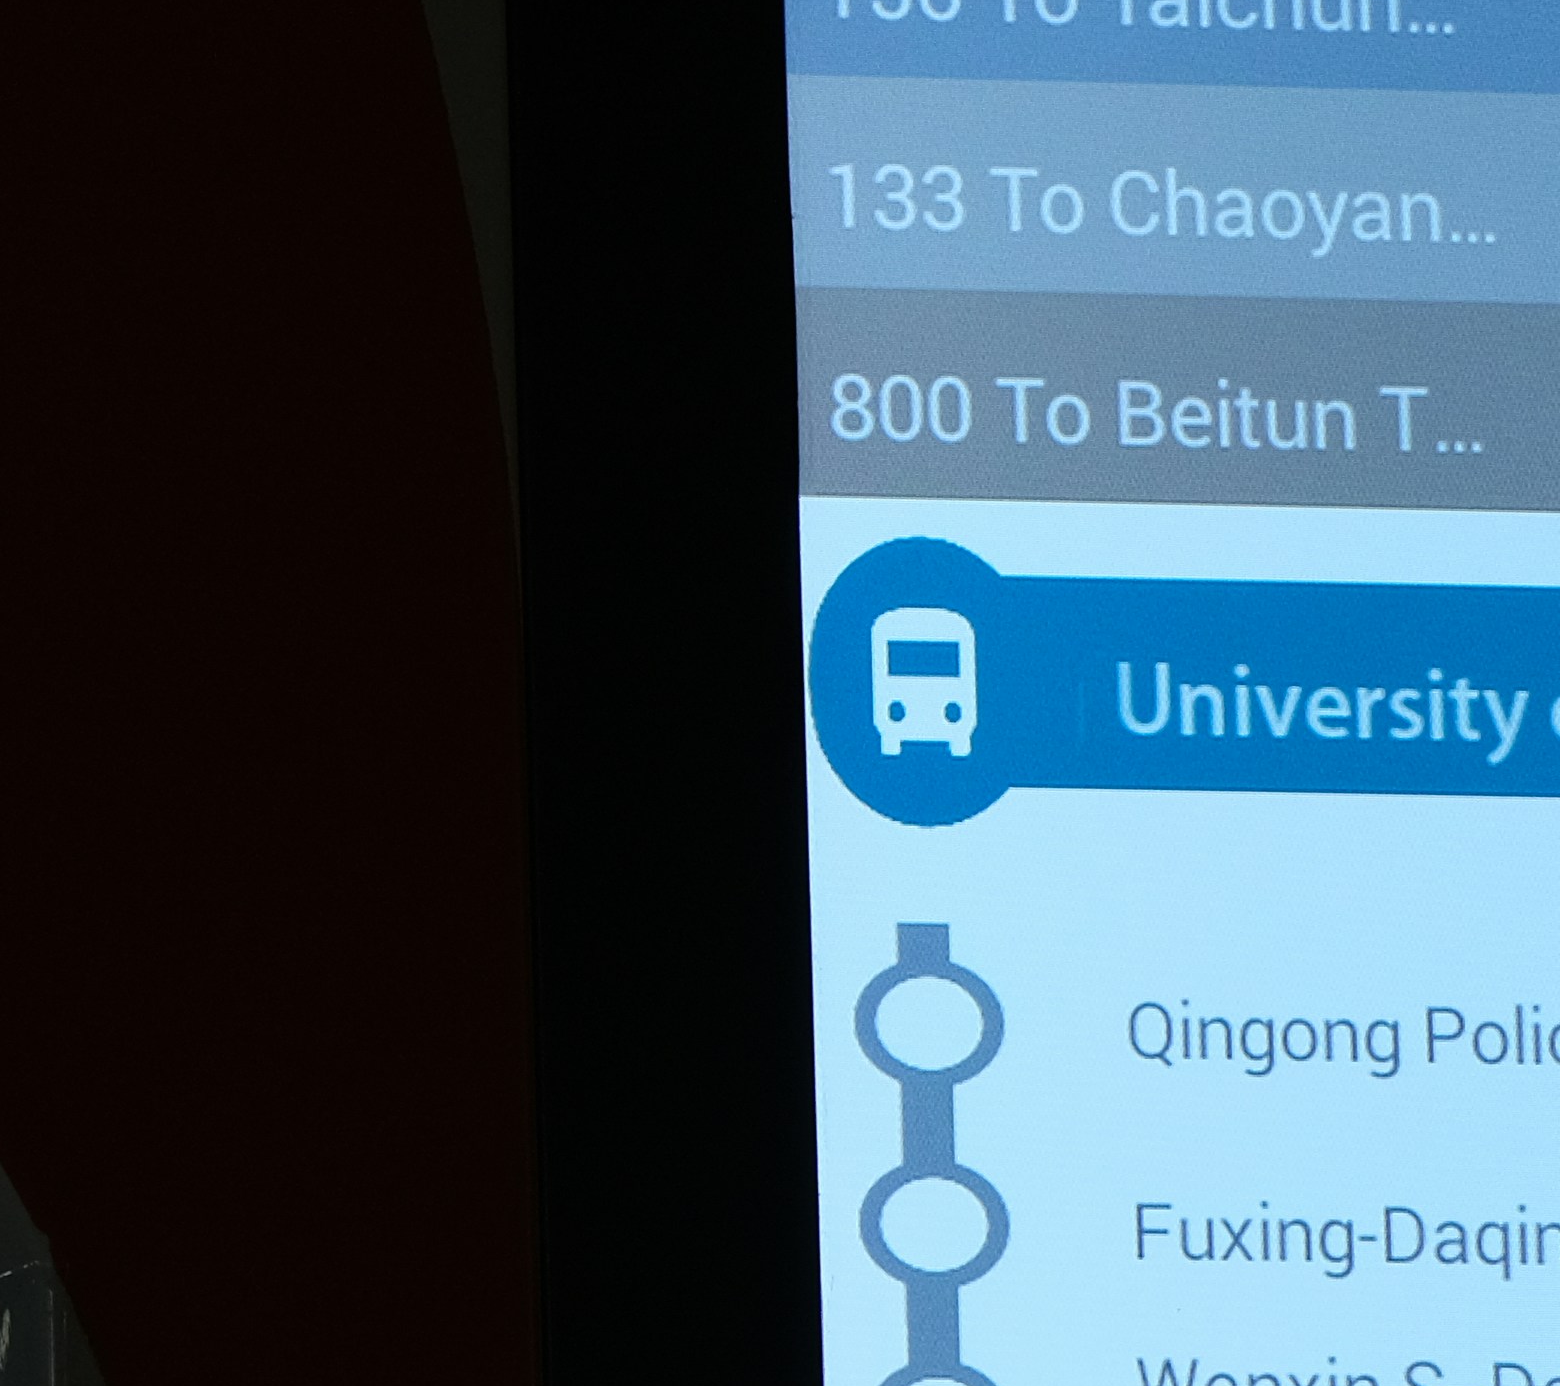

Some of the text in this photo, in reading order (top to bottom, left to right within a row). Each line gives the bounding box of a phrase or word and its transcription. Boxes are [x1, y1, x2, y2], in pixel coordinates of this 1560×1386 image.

[829, 163, 965, 232] 133
[989, 166, 1085, 235] To
[831, 373, 972, 443] 800
[995, 377, 1091, 446] To
[1118, 377, 1356, 450] Beitun
[1117, 661, 1530, 765] University
[1128, 998, 1401, 1080] Qingong
